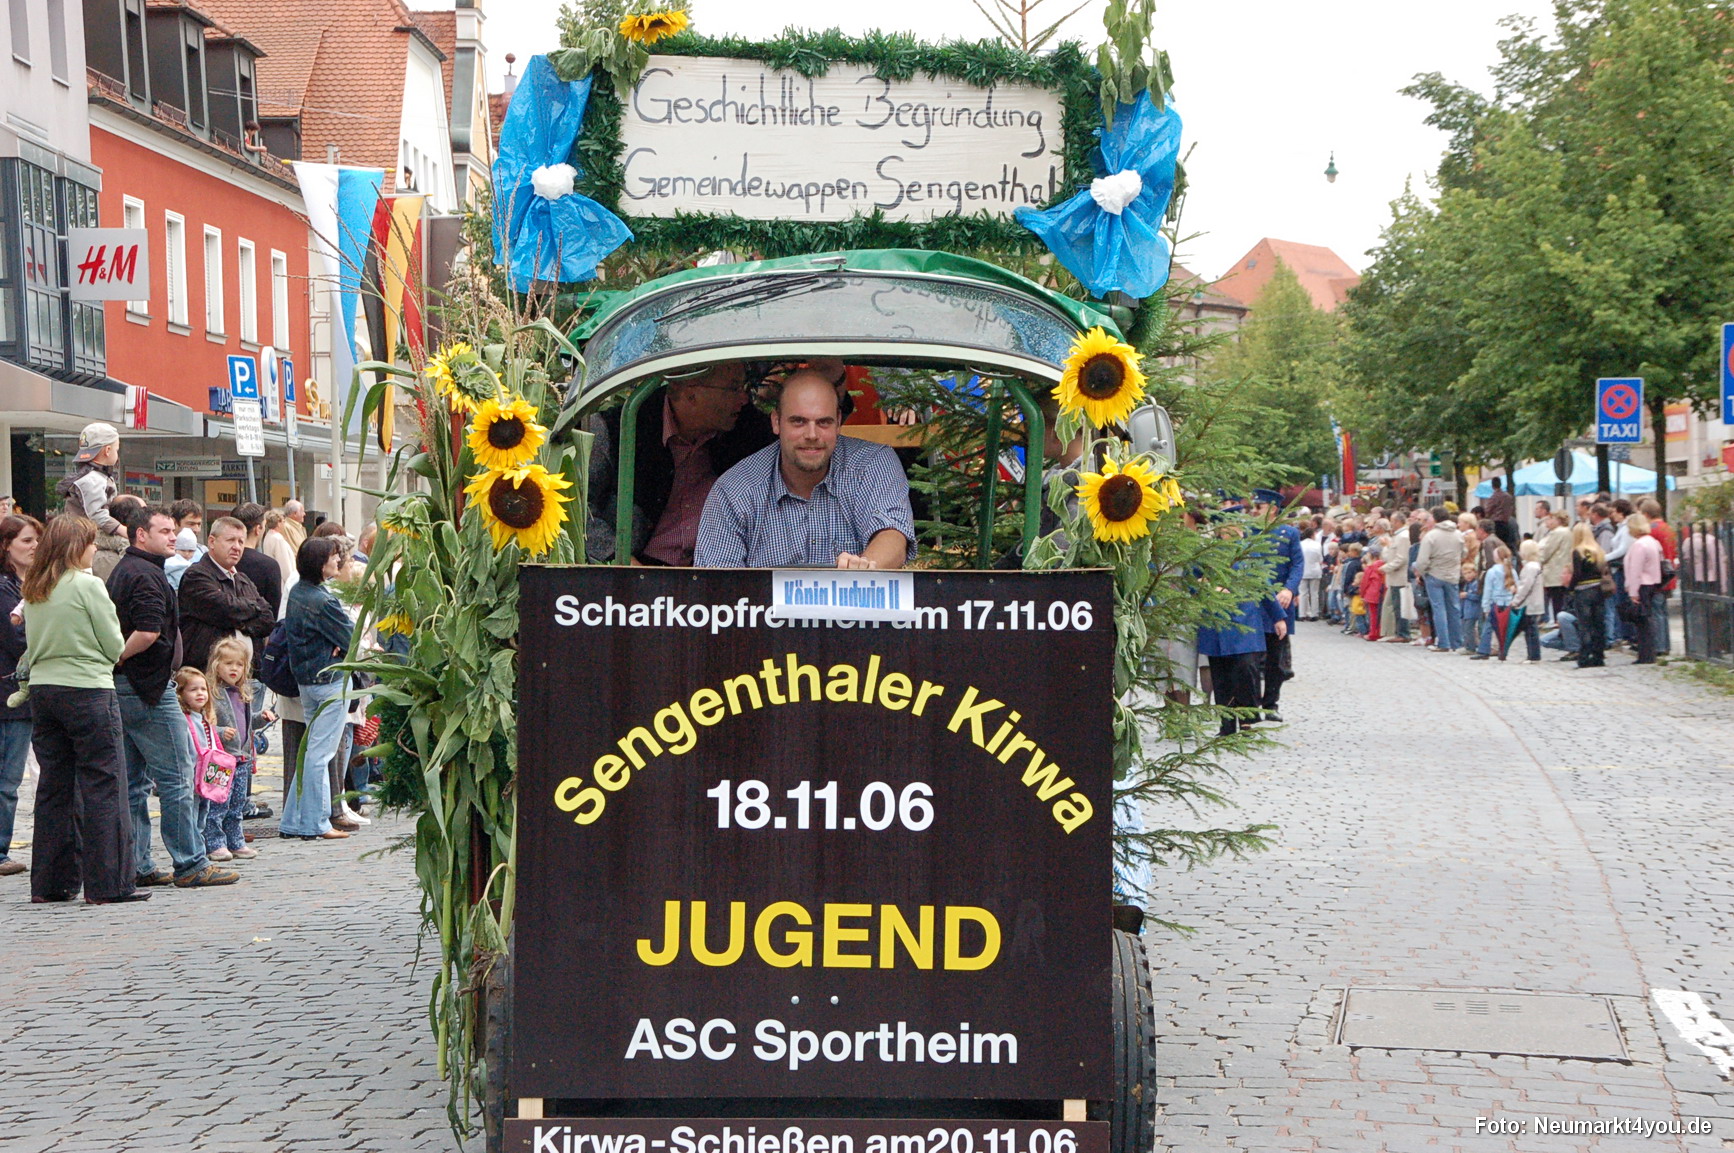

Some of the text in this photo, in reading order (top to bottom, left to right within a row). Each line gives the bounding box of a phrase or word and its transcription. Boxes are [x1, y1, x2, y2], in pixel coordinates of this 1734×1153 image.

[633, 67, 843, 127] Geschichtliche
[622, 147, 1056, 216] Gemeindewappen Sengenthal
[77, 244, 139, 286] H&M
[234, 361, 251, 394] P
[1600, 423, 1638, 438] TAXI
[957, 599, 1093, 631] 17.11.06
[553, 652, 1094, 834] Sengenthaler Kirwa
[706, 779, 935, 831] 18.11.06
[636, 900, 1001, 971] JUGEND
[624, 1018, 1019, 1071] ASC Sportheim
